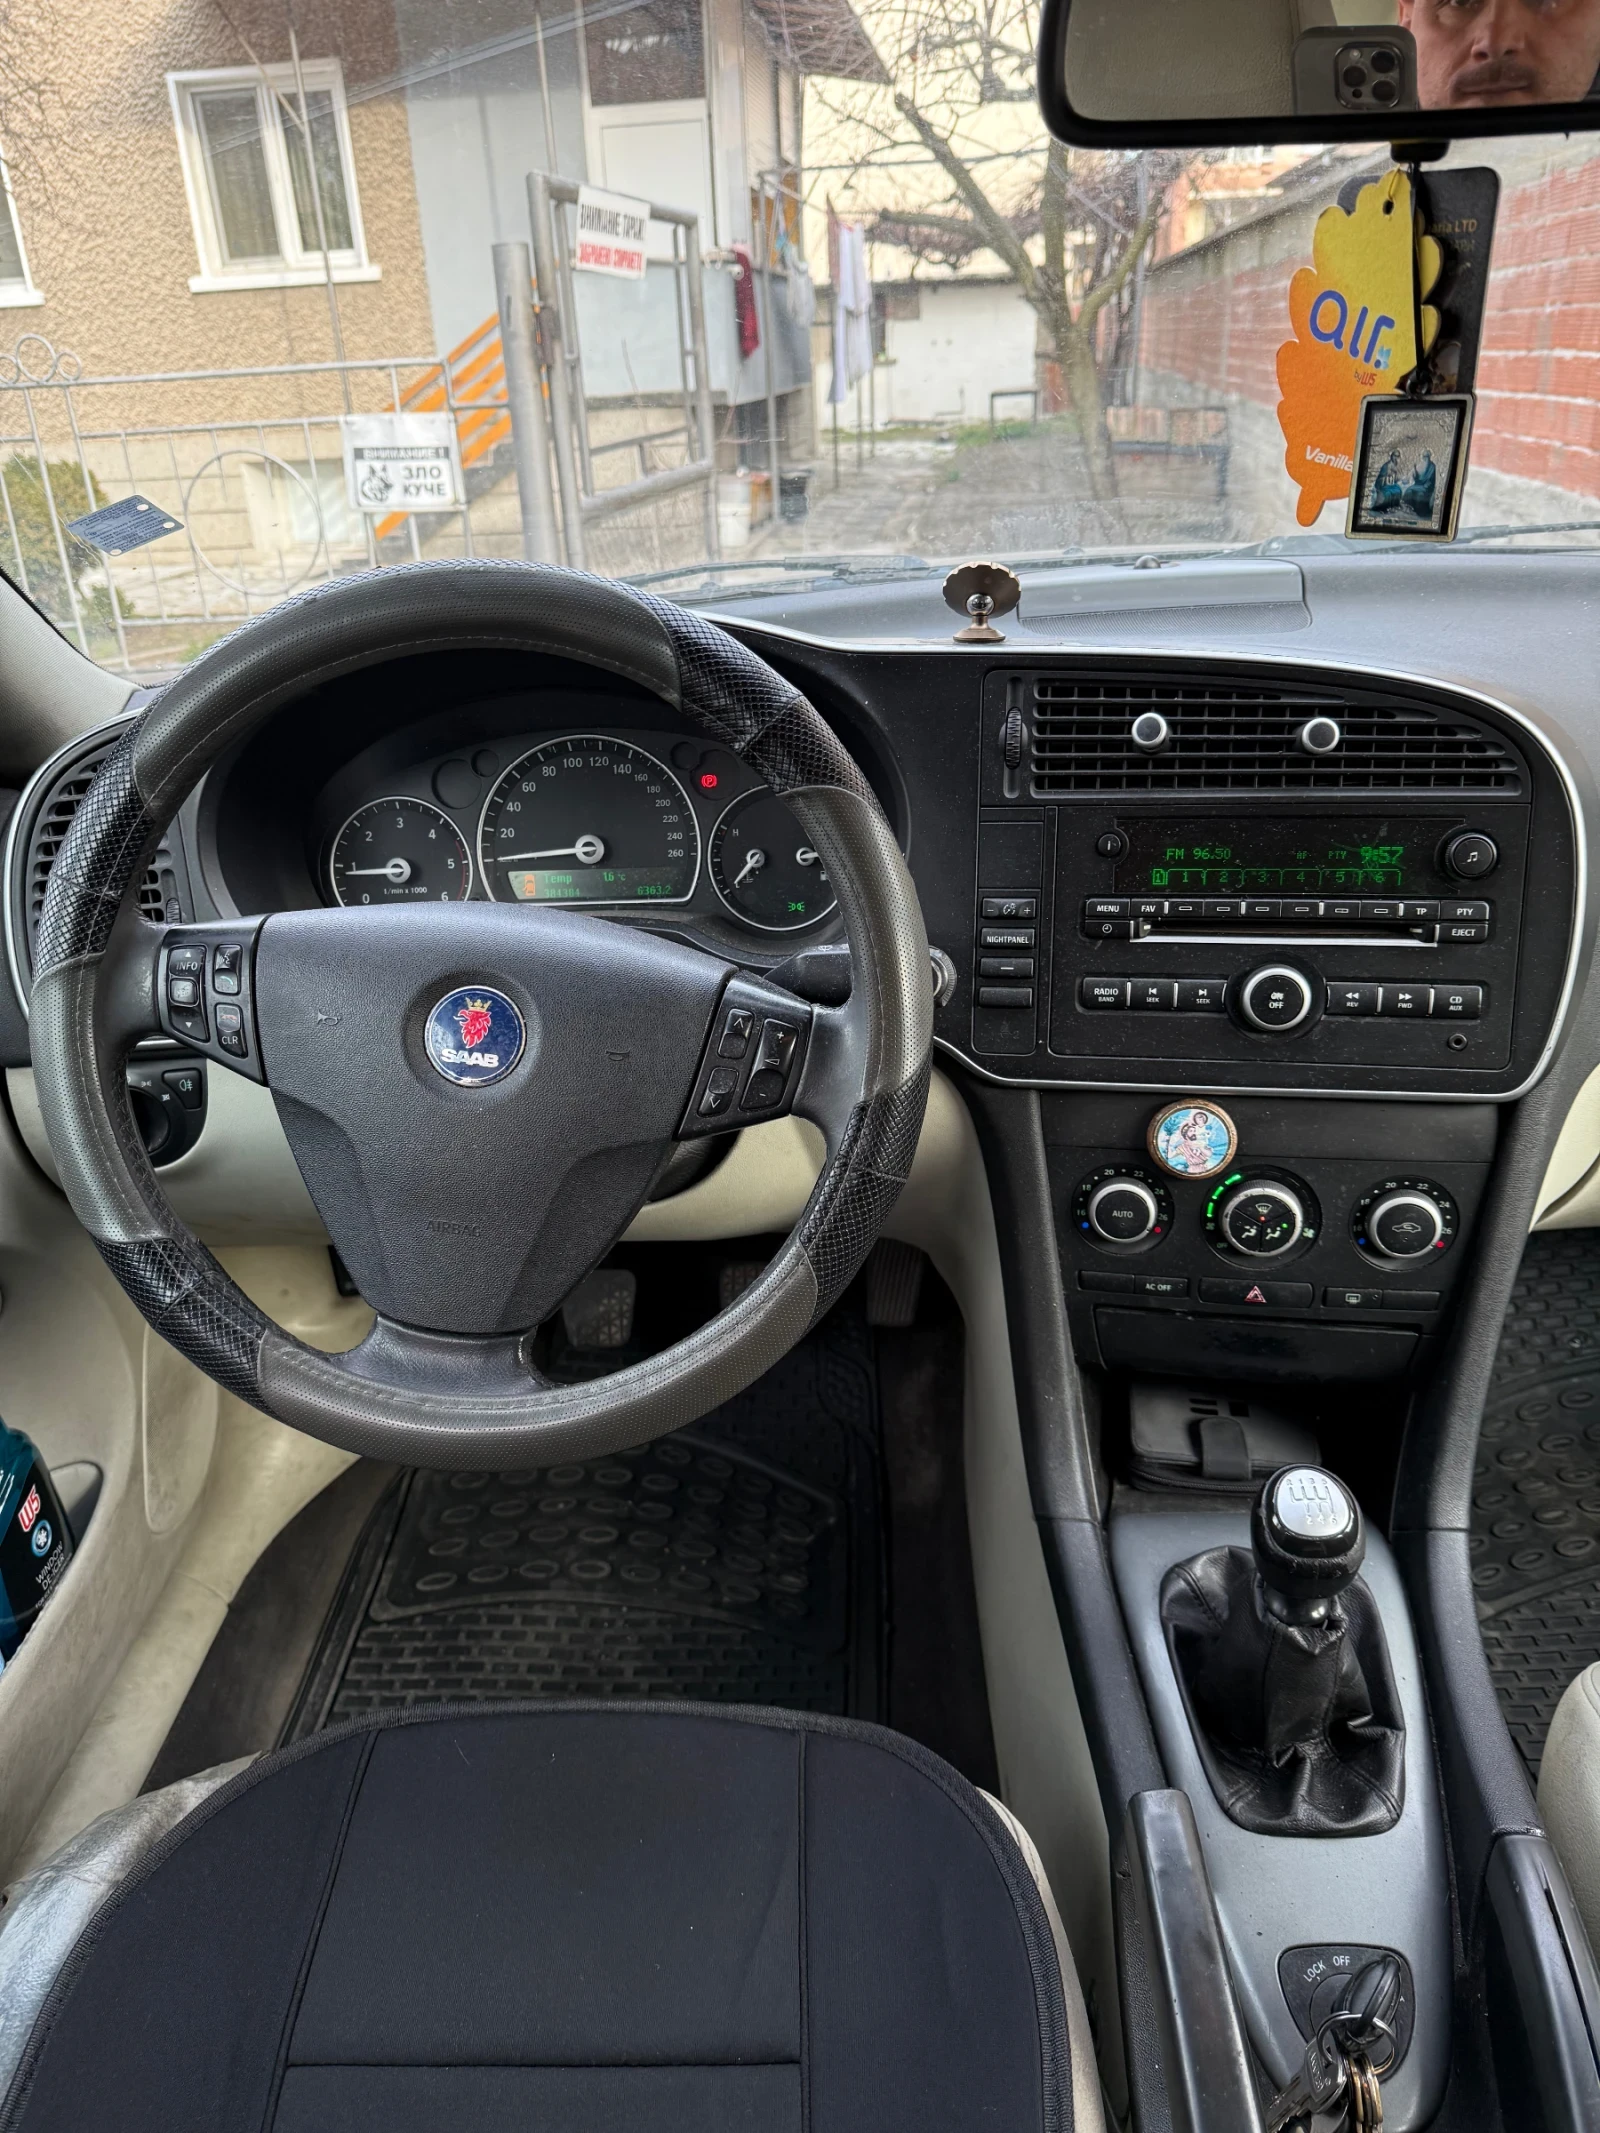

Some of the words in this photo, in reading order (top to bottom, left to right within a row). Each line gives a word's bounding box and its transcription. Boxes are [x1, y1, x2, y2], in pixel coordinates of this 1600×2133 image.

[1454, 218, 1477, 233] LTD
[1305, 445, 1354, 473] Vanilla
[403, 466, 442, 480] ЗЛО
[404, 483, 447, 498] КУЧЕ
[563, 757, 583, 768] 100
[589, 756, 609, 767] 120
[542, 766, 556, 777] 80
[613, 763, 632, 775] 140
[634, 773, 648, 782] 160
[522, 782, 536, 792] 60
[646, 785, 661, 794] 180
[506, 801, 521, 812] 40
[655, 799, 671, 807] 200
[396, 817, 404, 828] 3
[662, 815, 679, 823] 220
[365, 831, 373, 841] 2
[428, 829, 436, 839] 4
[500, 827, 515, 838] 20
[667, 832, 683, 840] 240
[732, 828, 739, 837] H
[667, 849, 684, 857] 260
[1166, 848, 1184, 860] FM
[1193, 848, 1232, 860] 96.50
[447, 858, 455, 869] 5
[544, 874, 572, 885] Temp
[1219, 871, 1228, 882] 2
[1258, 872, 1267, 883] 3
[1297, 872, 1306, 882] 4
[1335, 872, 1345, 883] 5
[410, 886, 428, 894] 1000
[637, 885, 672, 896] 6363.2
[362, 893, 370, 904] 0
[441, 891, 449, 901] 6
[1096, 904, 1120, 913] MENU
[1141, 904, 1156, 913] FAV
[1415, 907, 1427, 915] TP
[1456, 907, 1473, 916] PTY
[1451, 928, 1476, 937] EJECT
[986, 935, 1029, 944] NIGHTPANEL
[176, 961, 198, 970] INFO
[1094, 987, 1119, 996] RADIO
[1449, 995, 1462, 1004] CD
[1268, 1001, 1284, 1009] OFF
[222, 1036, 238, 1044] CLR
[440, 1048, 499, 1068] SAAB
[1111, 1210, 1133, 1218] AUTO
[426, 1220, 481, 1238] AIRBAG
[18, 1483, 41, 1533] W5
[35, 1540, 63, 1584] WINDOW
[41, 1553, 65, 1591] DE-ICER
[1333, 1955, 1351, 1966] OFF
[1303, 1960, 1327, 1983] LOCK
